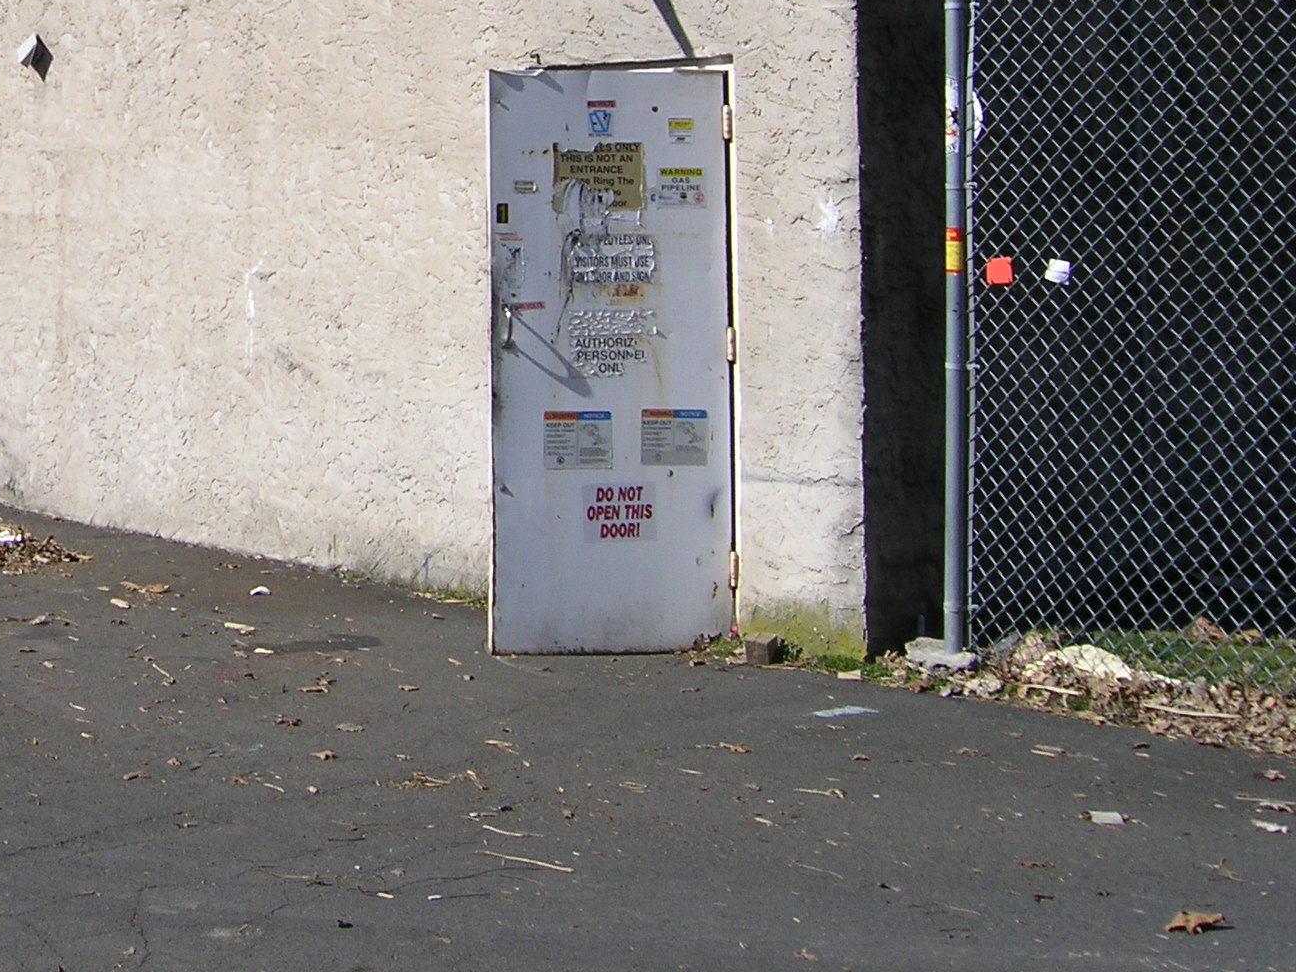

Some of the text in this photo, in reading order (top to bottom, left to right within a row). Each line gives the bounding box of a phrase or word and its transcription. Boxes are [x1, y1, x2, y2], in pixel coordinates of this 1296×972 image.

[614, 142, 640, 152] ONLY
[560, 154, 634, 163] THIS IS NOT AN
[569, 165, 624, 174] ENTRANCE
[593, 176, 615, 186] Ring
[617, 176, 635, 185] The
[574, 256, 650, 267] VISITORS MUST USE
[596, 486, 643, 502] DO NOT
[587, 504, 652, 521] OPEN THIS
[600, 522, 640, 538] DOOR!
